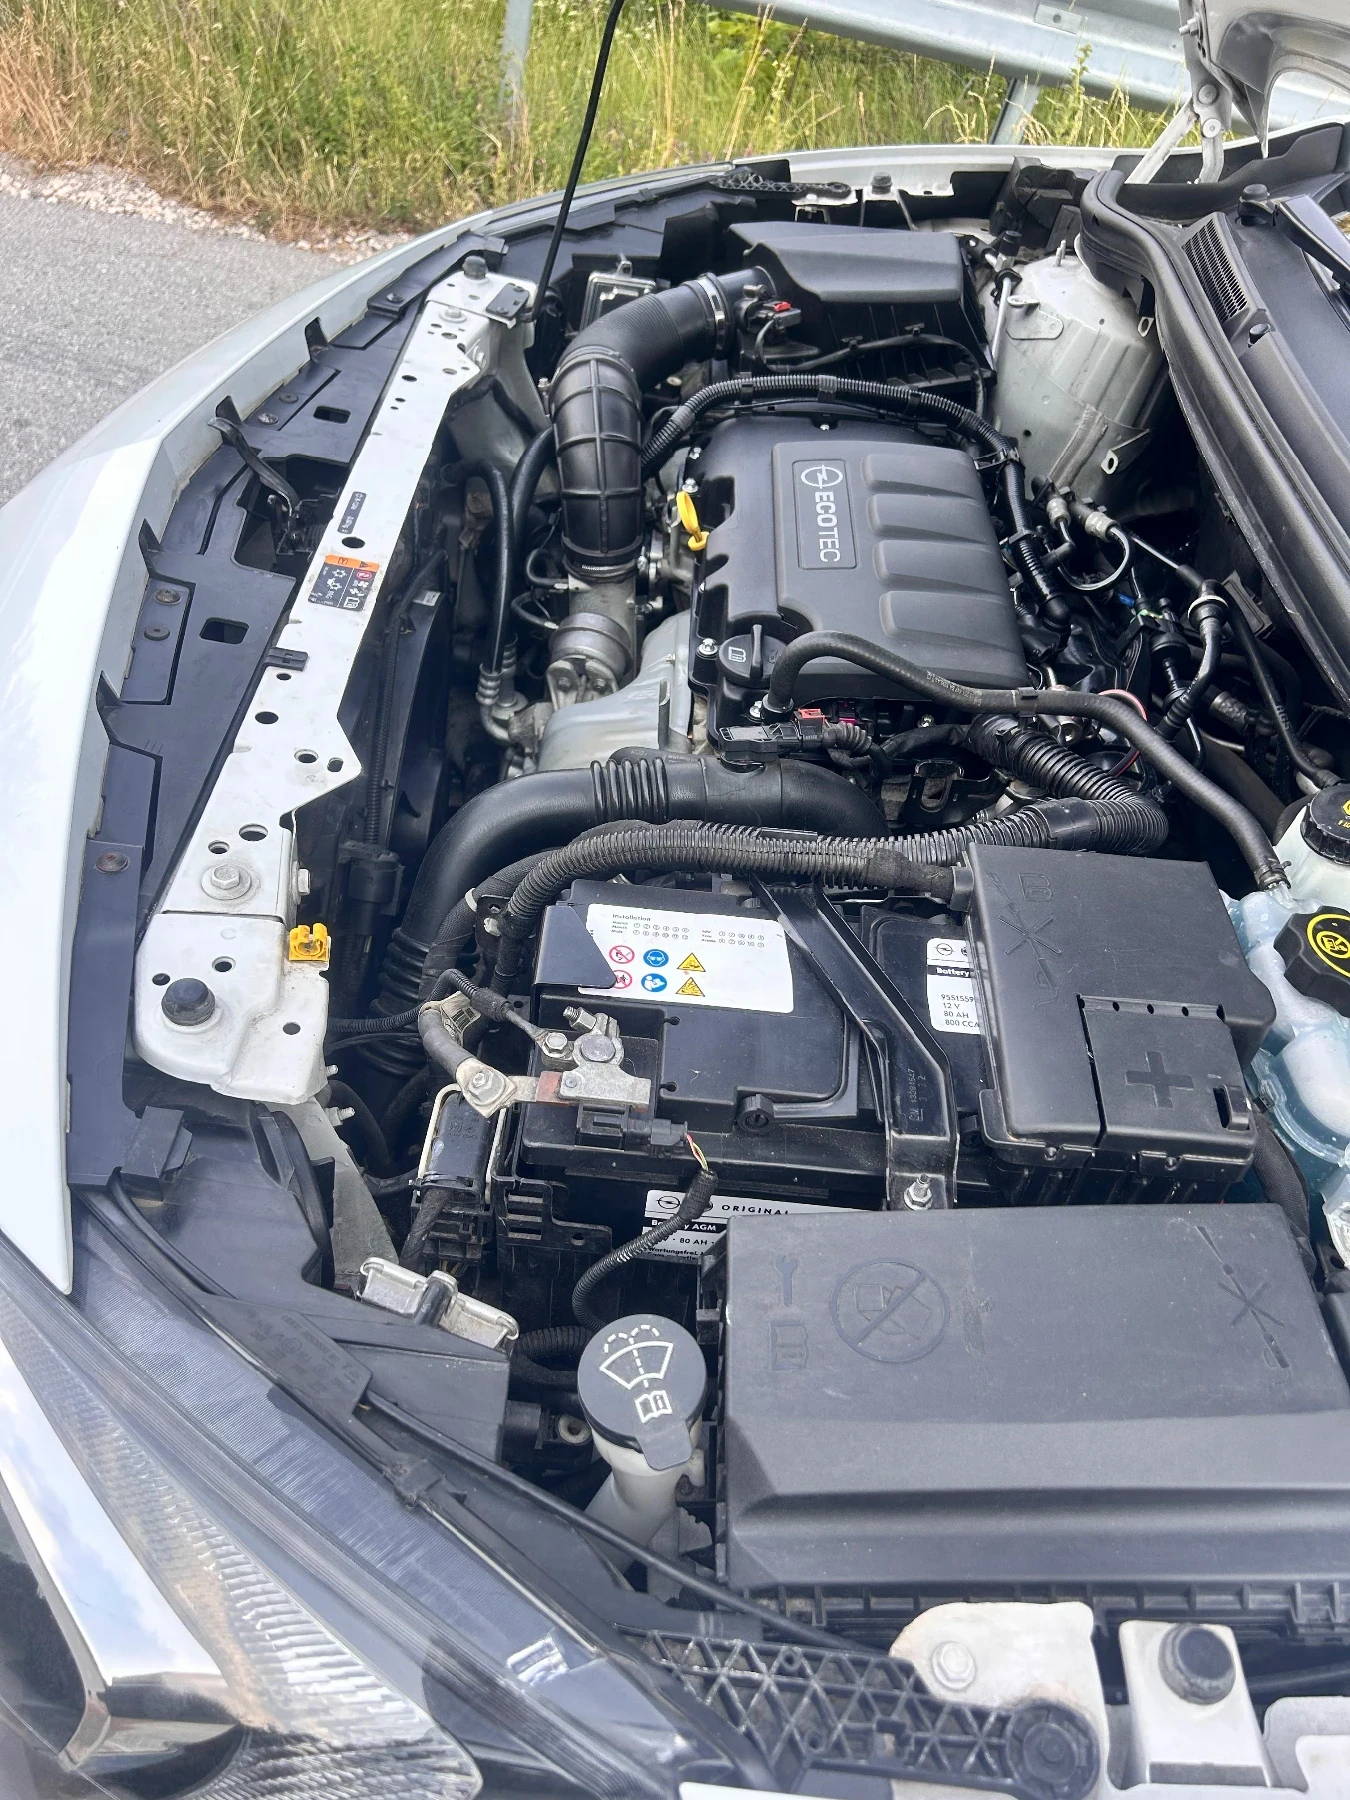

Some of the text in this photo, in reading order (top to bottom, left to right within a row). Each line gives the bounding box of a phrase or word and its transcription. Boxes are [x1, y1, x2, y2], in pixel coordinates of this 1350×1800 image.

[814, 491, 841, 562] ECOTEC
[612, 913, 651, 922] Installation
[936, 966, 970, 978] Battery
[956, 1011, 969, 1019] AH
[944, 1018, 980, 1028] 800 CCA
[692, 1223, 717, 1231] AGM
